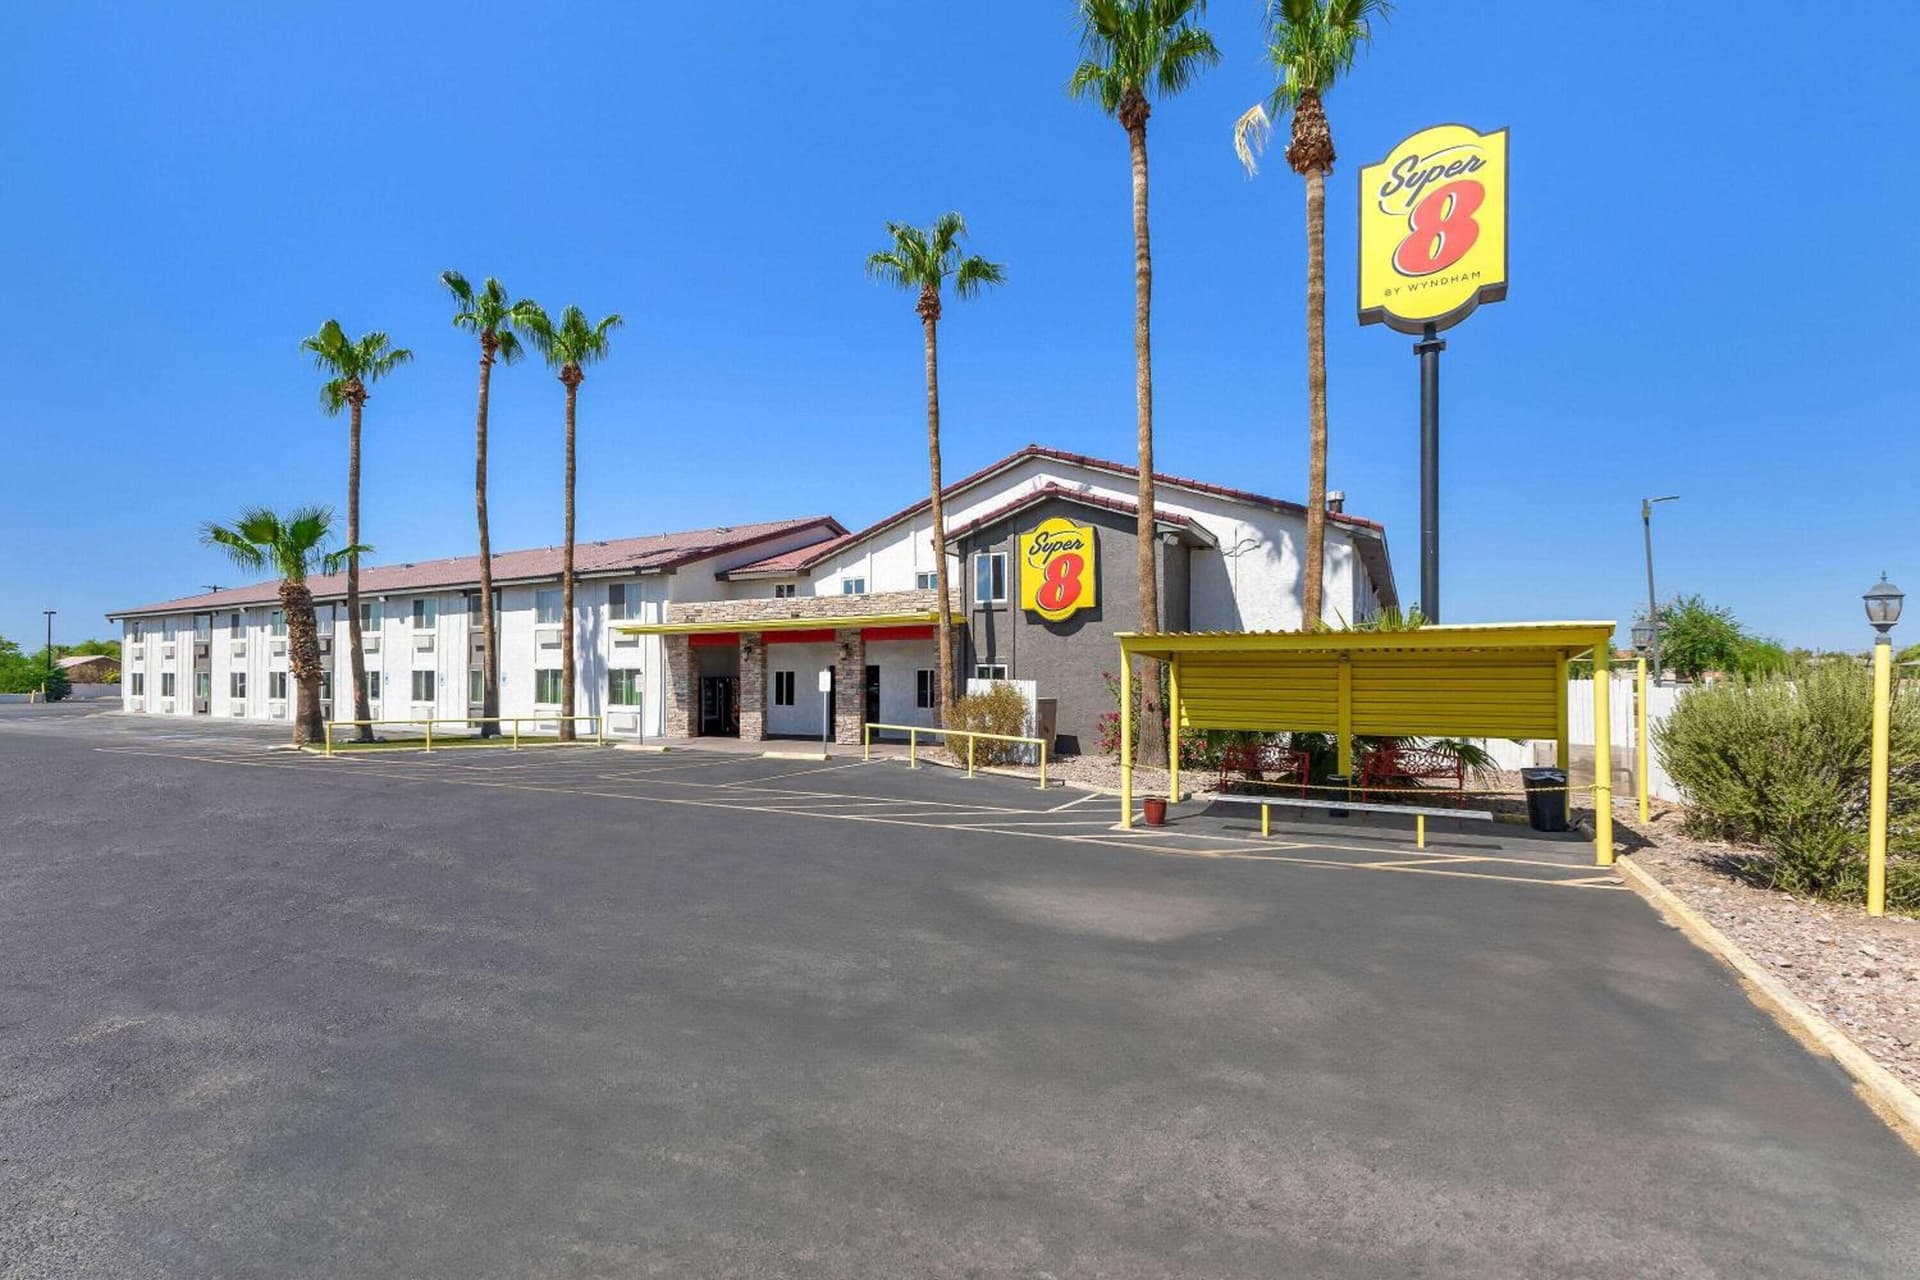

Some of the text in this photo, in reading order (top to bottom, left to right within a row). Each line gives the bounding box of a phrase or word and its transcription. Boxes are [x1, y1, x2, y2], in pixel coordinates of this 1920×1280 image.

[1380, 154, 1487, 207] Super
[1392, 179, 1485, 277] 8
[1384, 270, 1481, 297] BY WYNDHAM
[1029, 531, 1084, 565] Super
[1036, 553, 1084, 612] 8
